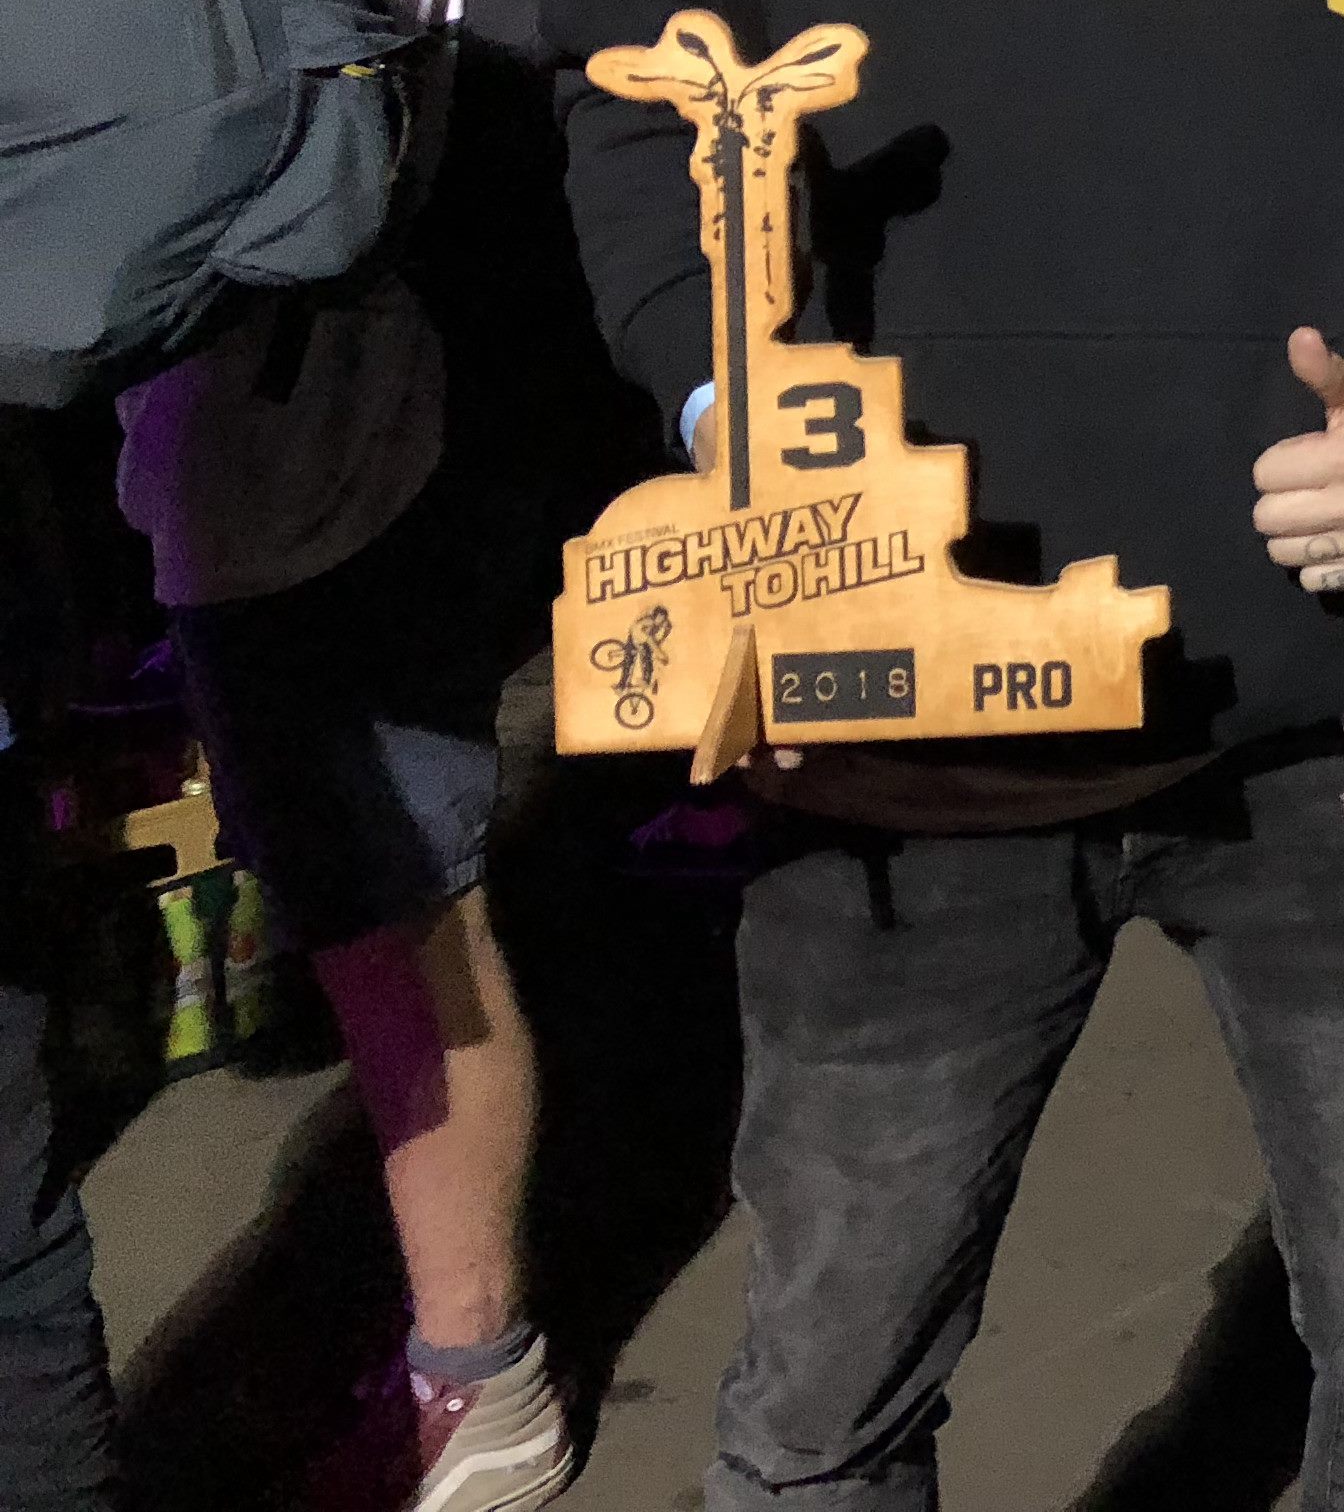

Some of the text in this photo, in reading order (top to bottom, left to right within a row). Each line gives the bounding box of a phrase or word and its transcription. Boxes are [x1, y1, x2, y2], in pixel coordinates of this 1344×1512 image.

[777, 381, 867, 469] 3
[586, 492, 863, 605] HIGHWAY
[720, 529, 925, 618] TO HILL
[780, 667, 910, 704] 2018
[973, 660, 1073, 713] PRO
